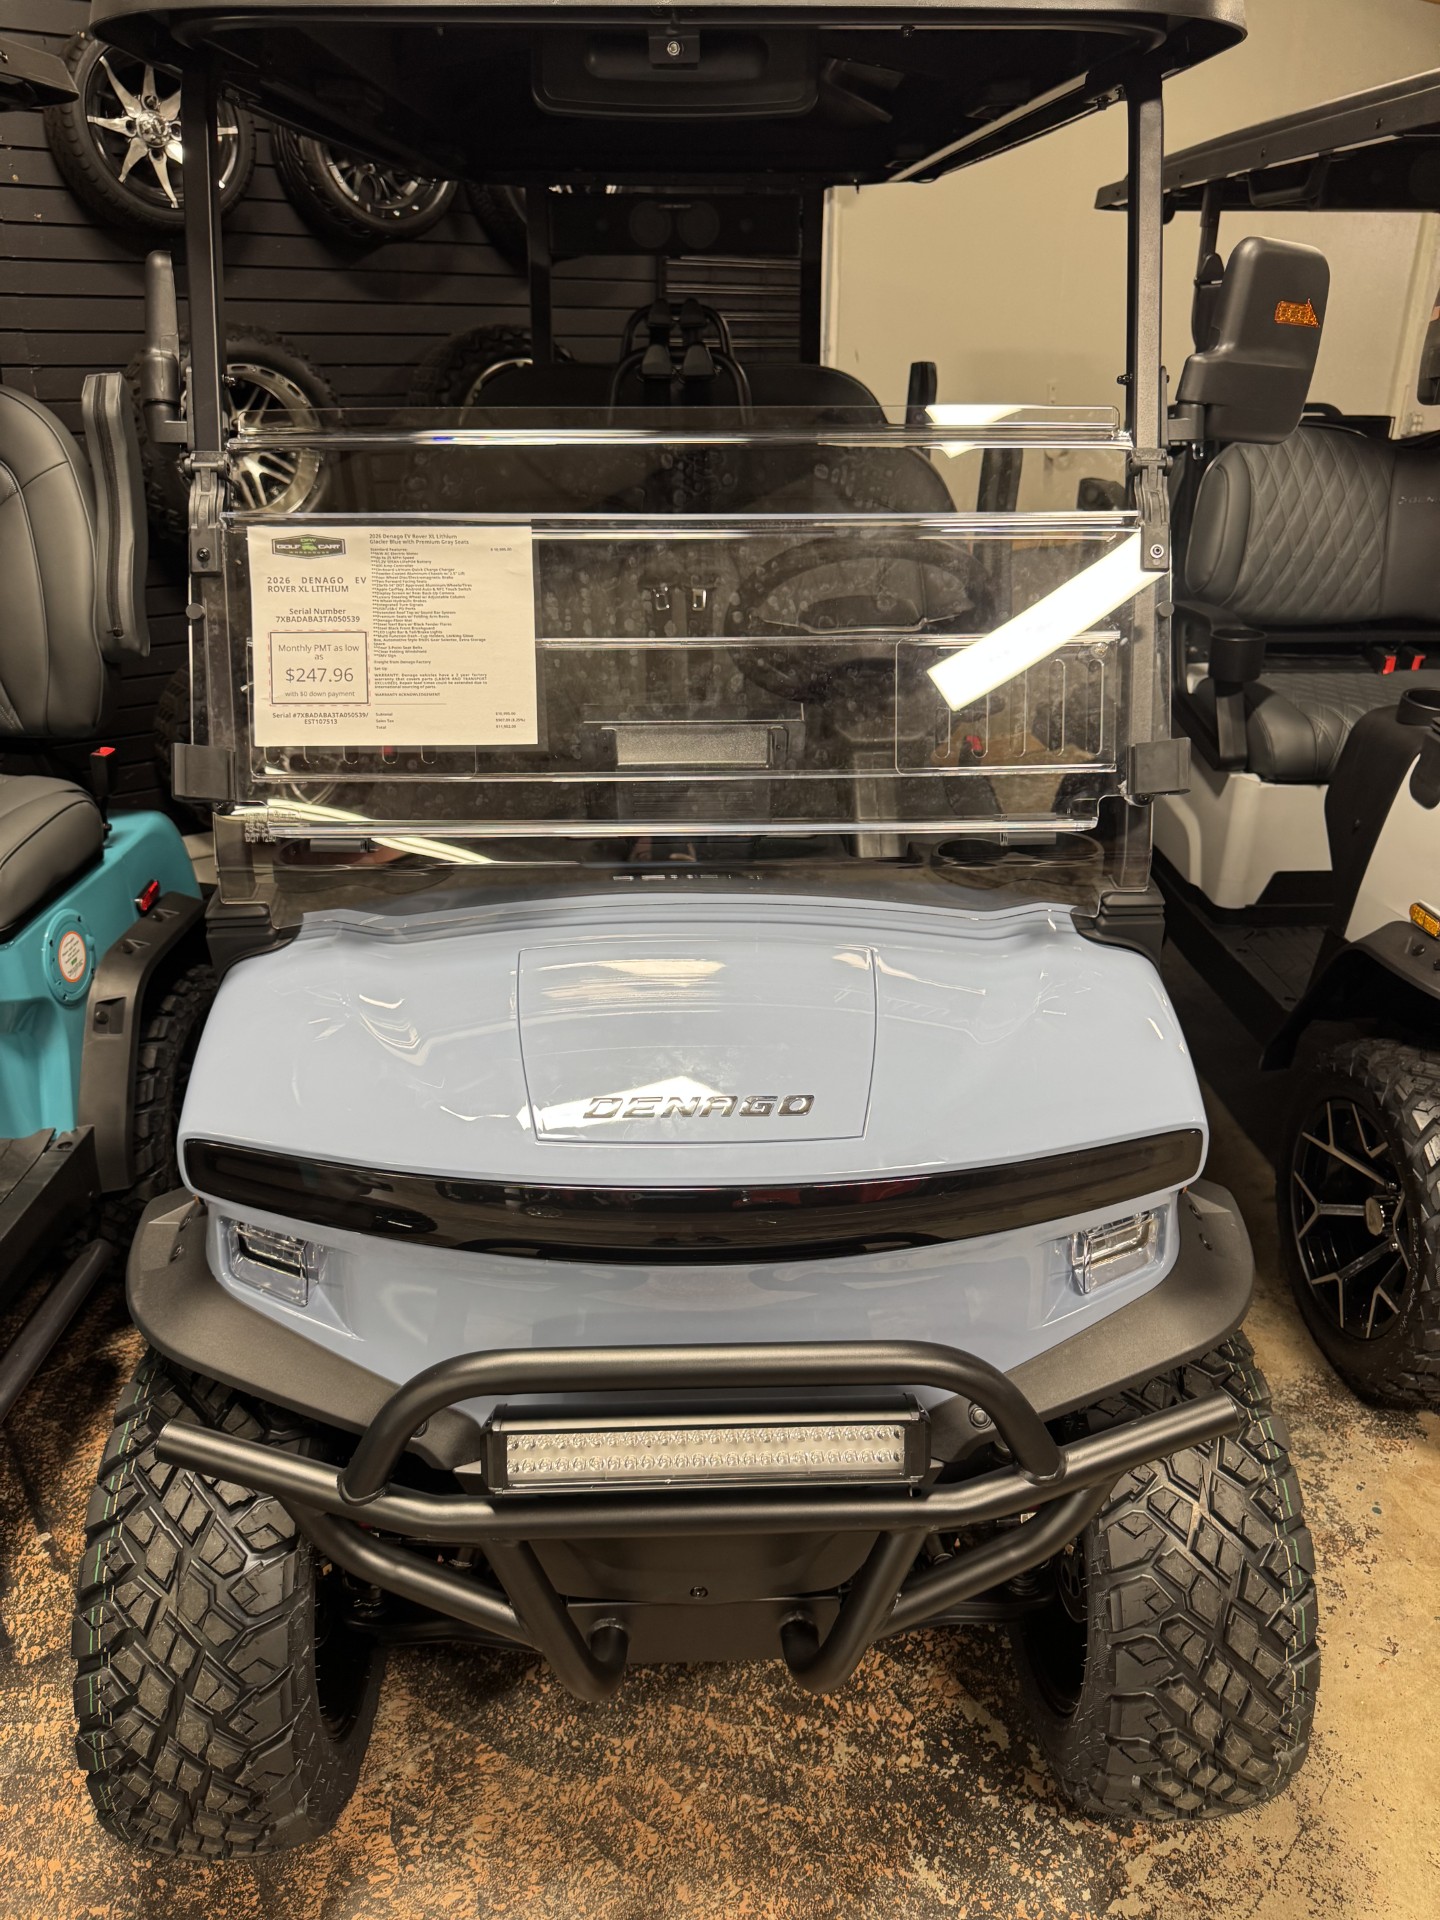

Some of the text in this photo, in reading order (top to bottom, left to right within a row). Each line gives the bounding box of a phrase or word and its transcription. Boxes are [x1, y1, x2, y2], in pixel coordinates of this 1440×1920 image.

[278, 644, 312, 653] Monthly
[285, 667, 354, 683] $247.96
[583, 1094, 815, 1119] DENAGO
